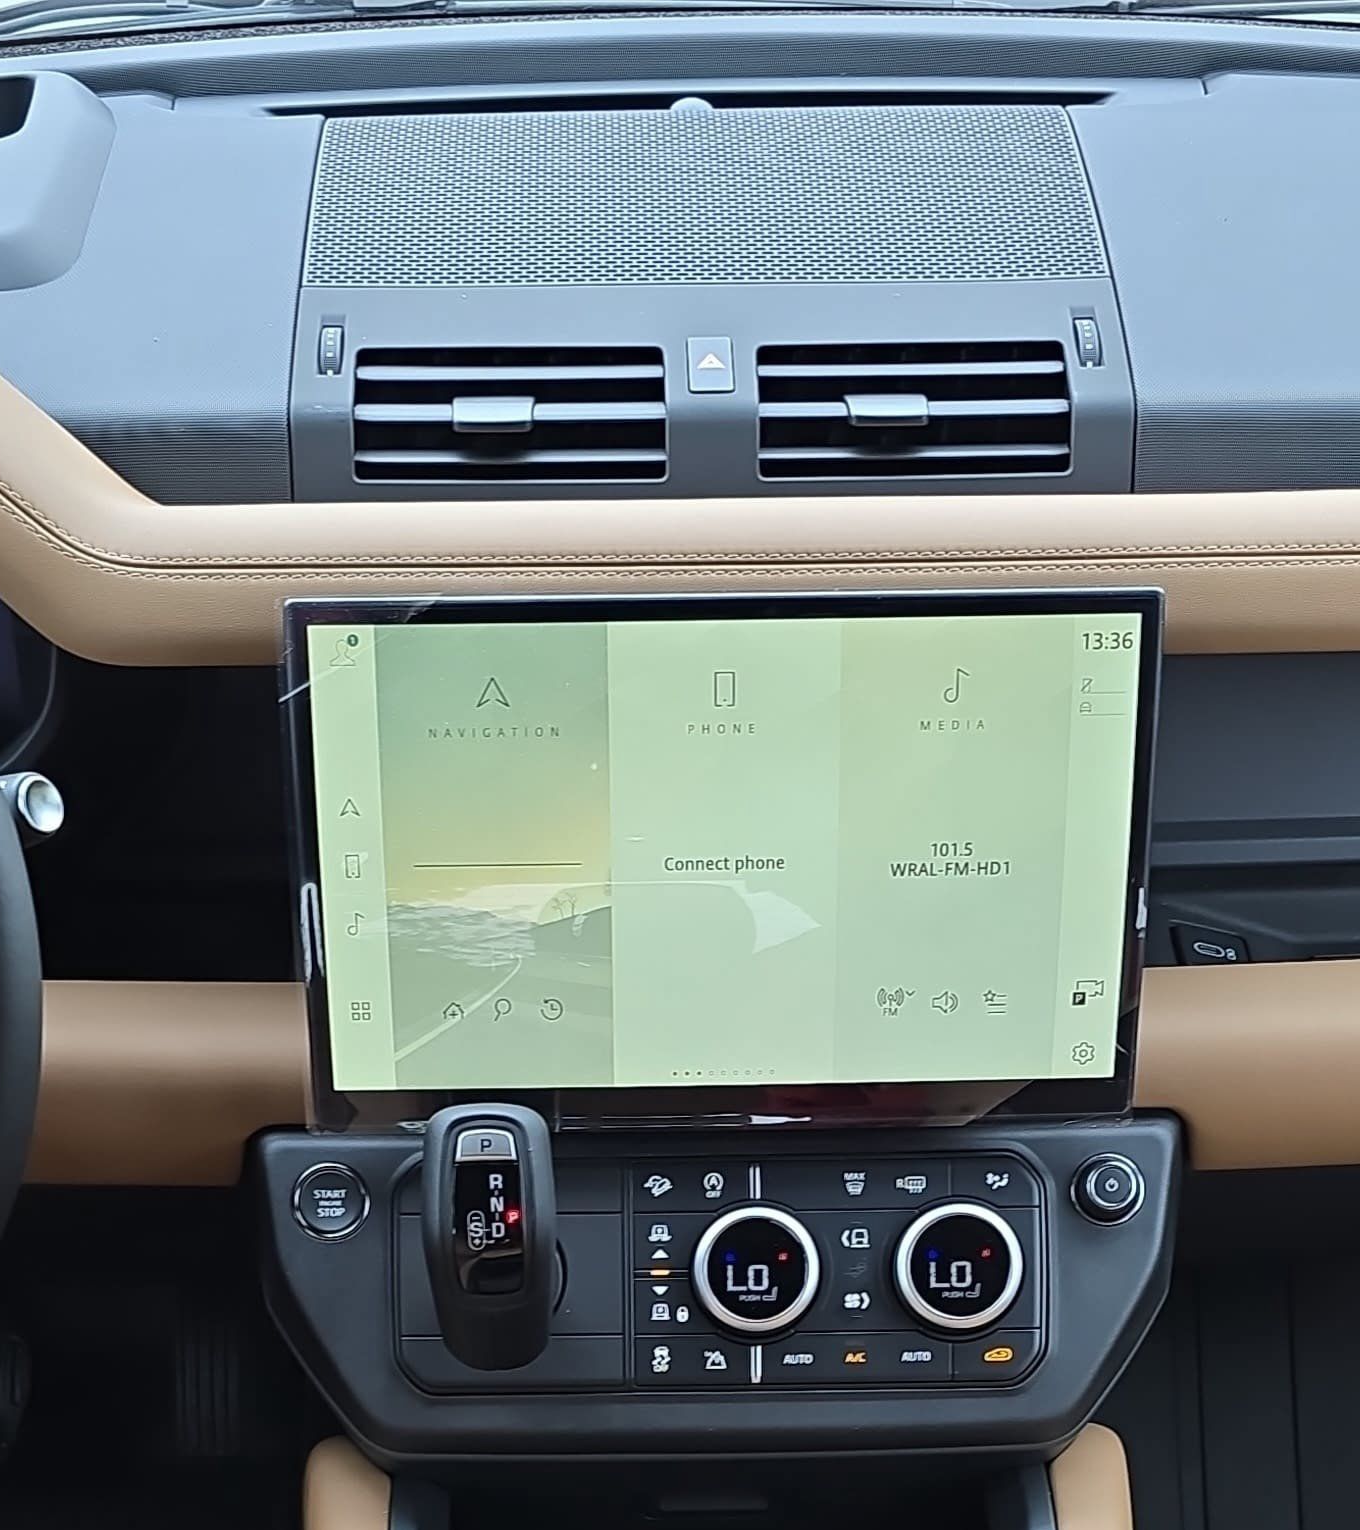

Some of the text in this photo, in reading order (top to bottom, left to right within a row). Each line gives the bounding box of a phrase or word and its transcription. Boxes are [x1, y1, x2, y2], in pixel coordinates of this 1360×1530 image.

[1081, 631, 1134, 651] 13:36
[688, 723, 756, 735] PHONE
[920, 720, 985, 731] MEDIA
[428, 727, 561, 738] NAVIGATION
[930, 842, 973, 858] 101.5
[664, 856, 785, 876] Connect phone
[890, 861, 1011, 878] WRAL-FM-HD1
[883, 1007, 898, 1016] FM
[480, 1139, 492, 1151] P
[489, 1174, 503, 1189] R
[313, 1189, 347, 1199] START
[490, 1197, 504, 1211] N
[317, 1207, 346, 1217] STOP
[470, 1222, 505, 1238] S D
[726, 1264, 769, 1292] LO
[929, 1261, 972, 1288] LO
[783, 1353, 814, 1365] AUTO
[845, 1352, 867, 1363] A/C
[901, 1351, 932, 1362] AUTO
